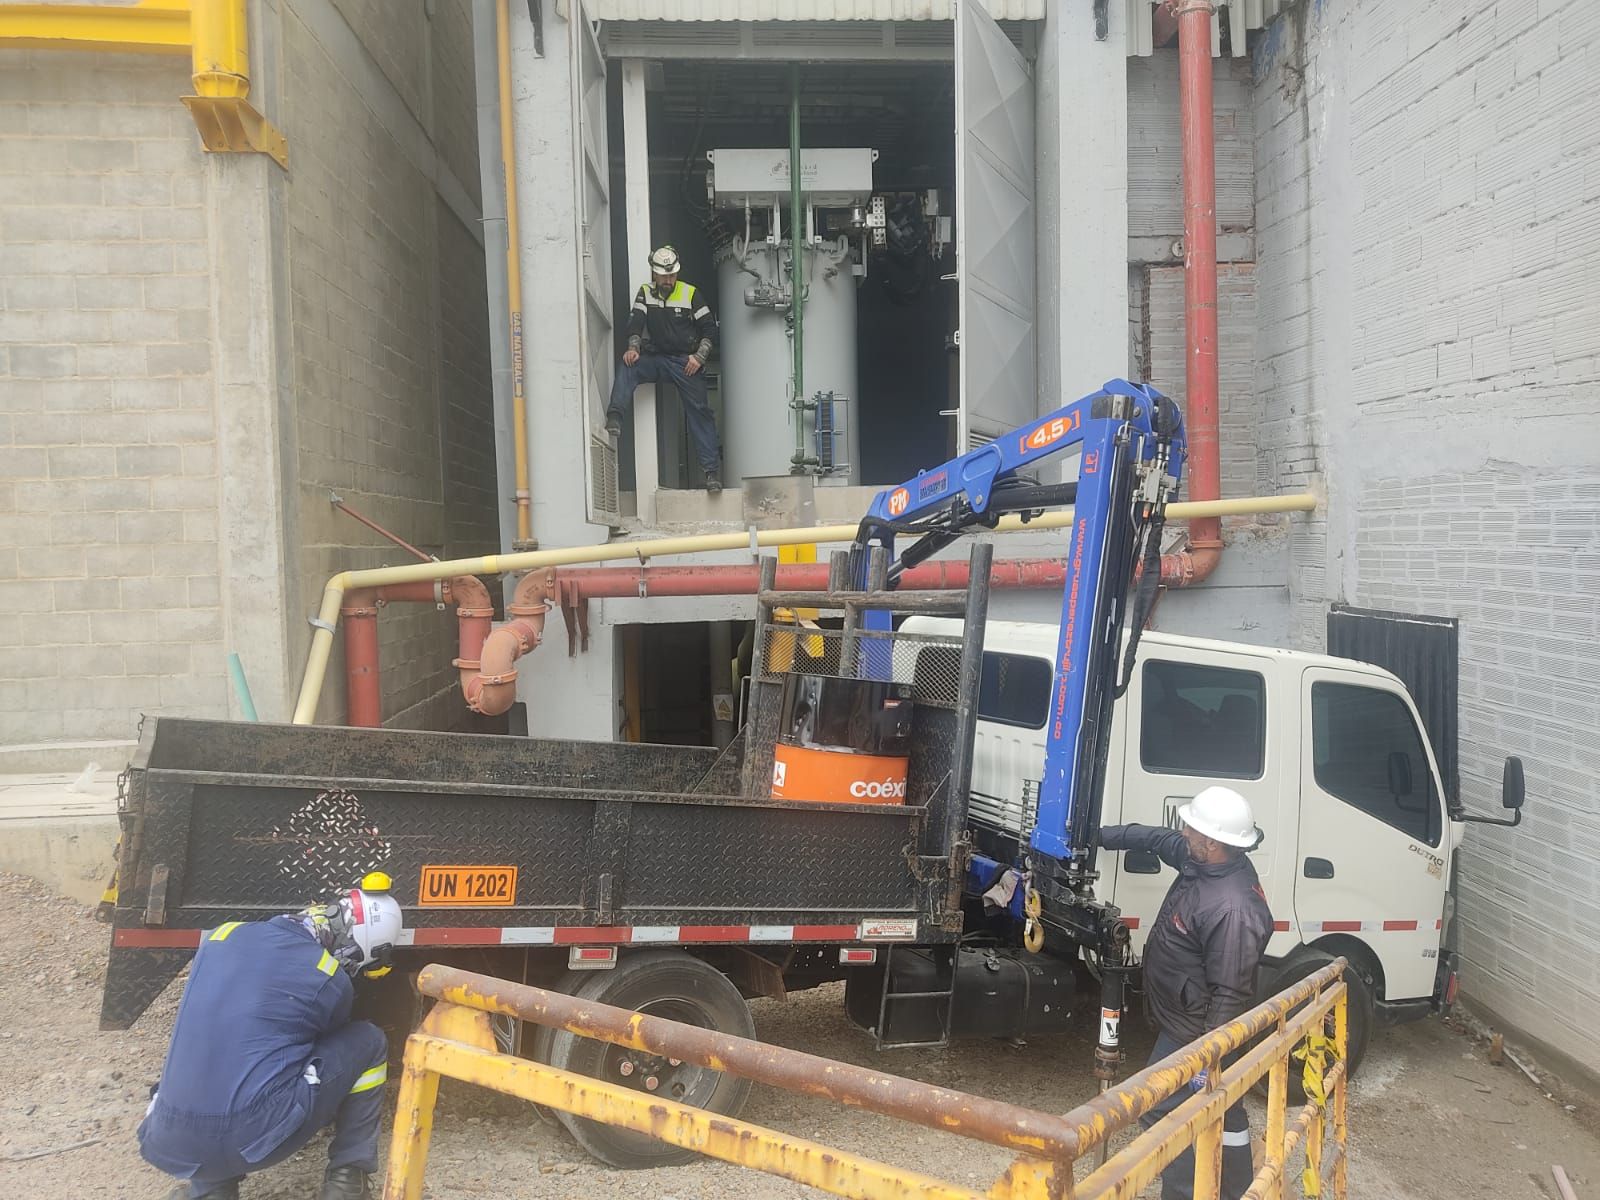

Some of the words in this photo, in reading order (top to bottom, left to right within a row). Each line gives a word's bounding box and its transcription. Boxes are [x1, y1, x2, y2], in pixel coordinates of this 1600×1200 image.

[513, 312, 522, 333] GAS
[513, 335, 523, 383] NATURAL
[1033, 418, 1065, 445] 4.5
[890, 489, 908, 515] PM
[1408, 844, 1444, 866] DUTRO
[429, 873, 458, 898] UN
[465, 873, 508, 898] 1202
